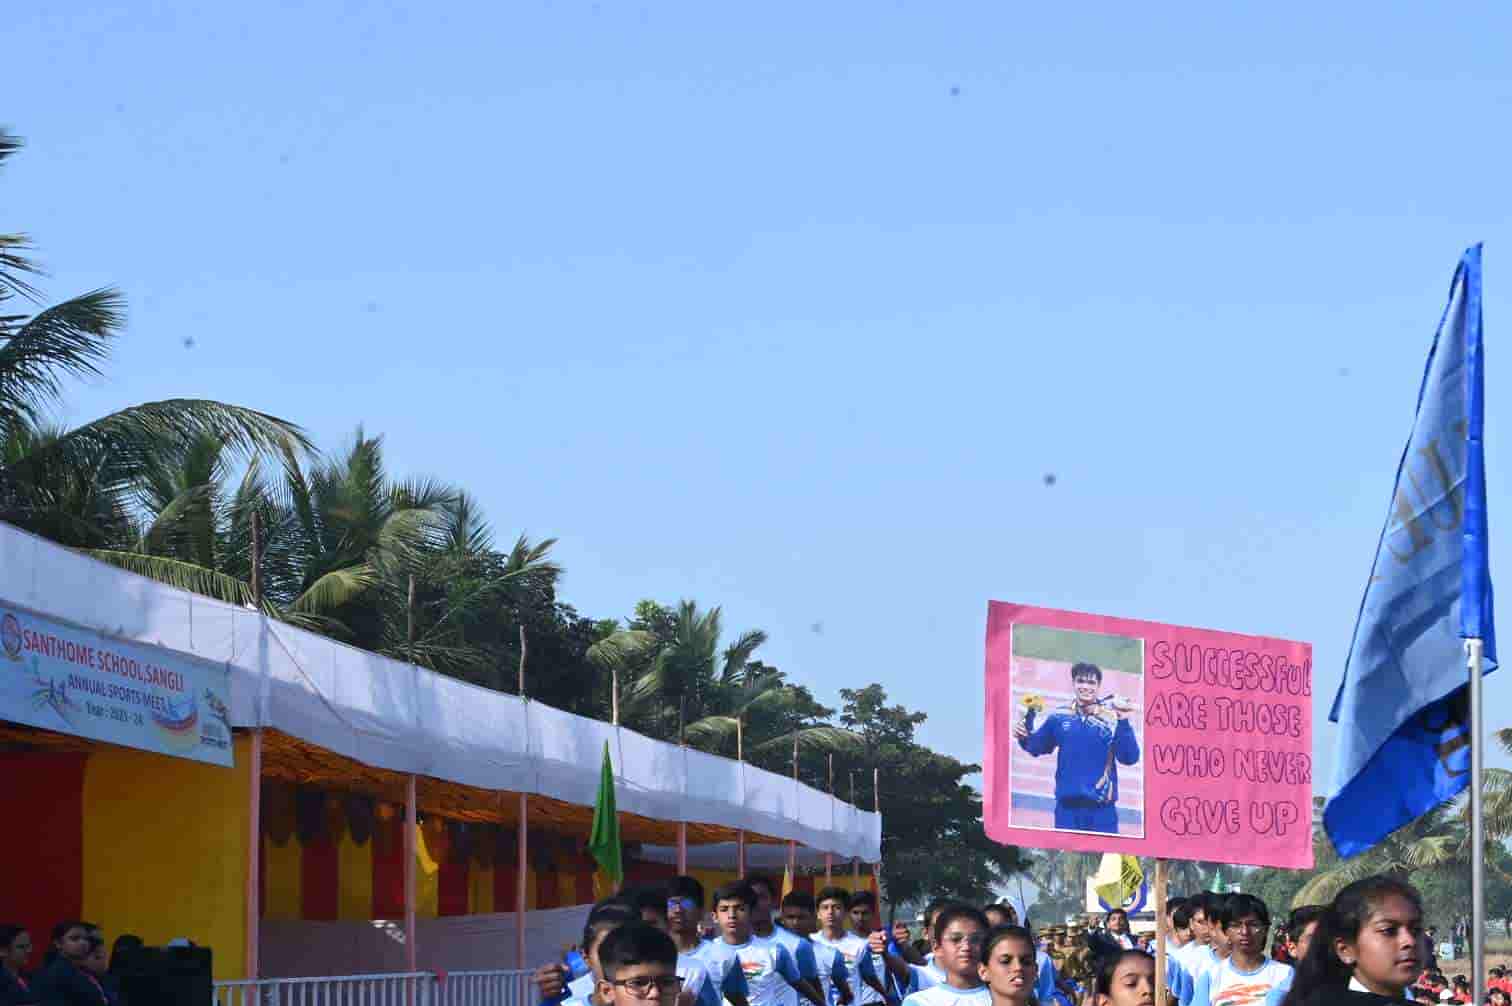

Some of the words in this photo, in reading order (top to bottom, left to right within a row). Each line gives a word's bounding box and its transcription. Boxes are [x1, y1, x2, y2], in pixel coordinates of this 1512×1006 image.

[24, 629, 95, 668] SANTHOME
[68, 672, 106, 698] ANNUAL
[107, 683, 142, 705] SPORTS
[143, 690, 168, 712] MEET
[1146, 692, 1207, 730] ARE
[1215, 697, 1301, 737] THOSE
[1153, 744, 1225, 777] WHO
[1233, 749, 1312, 784] NEVER
[1160, 796, 1241, 836] GIVE
[1250, 801, 1298, 836] UP
